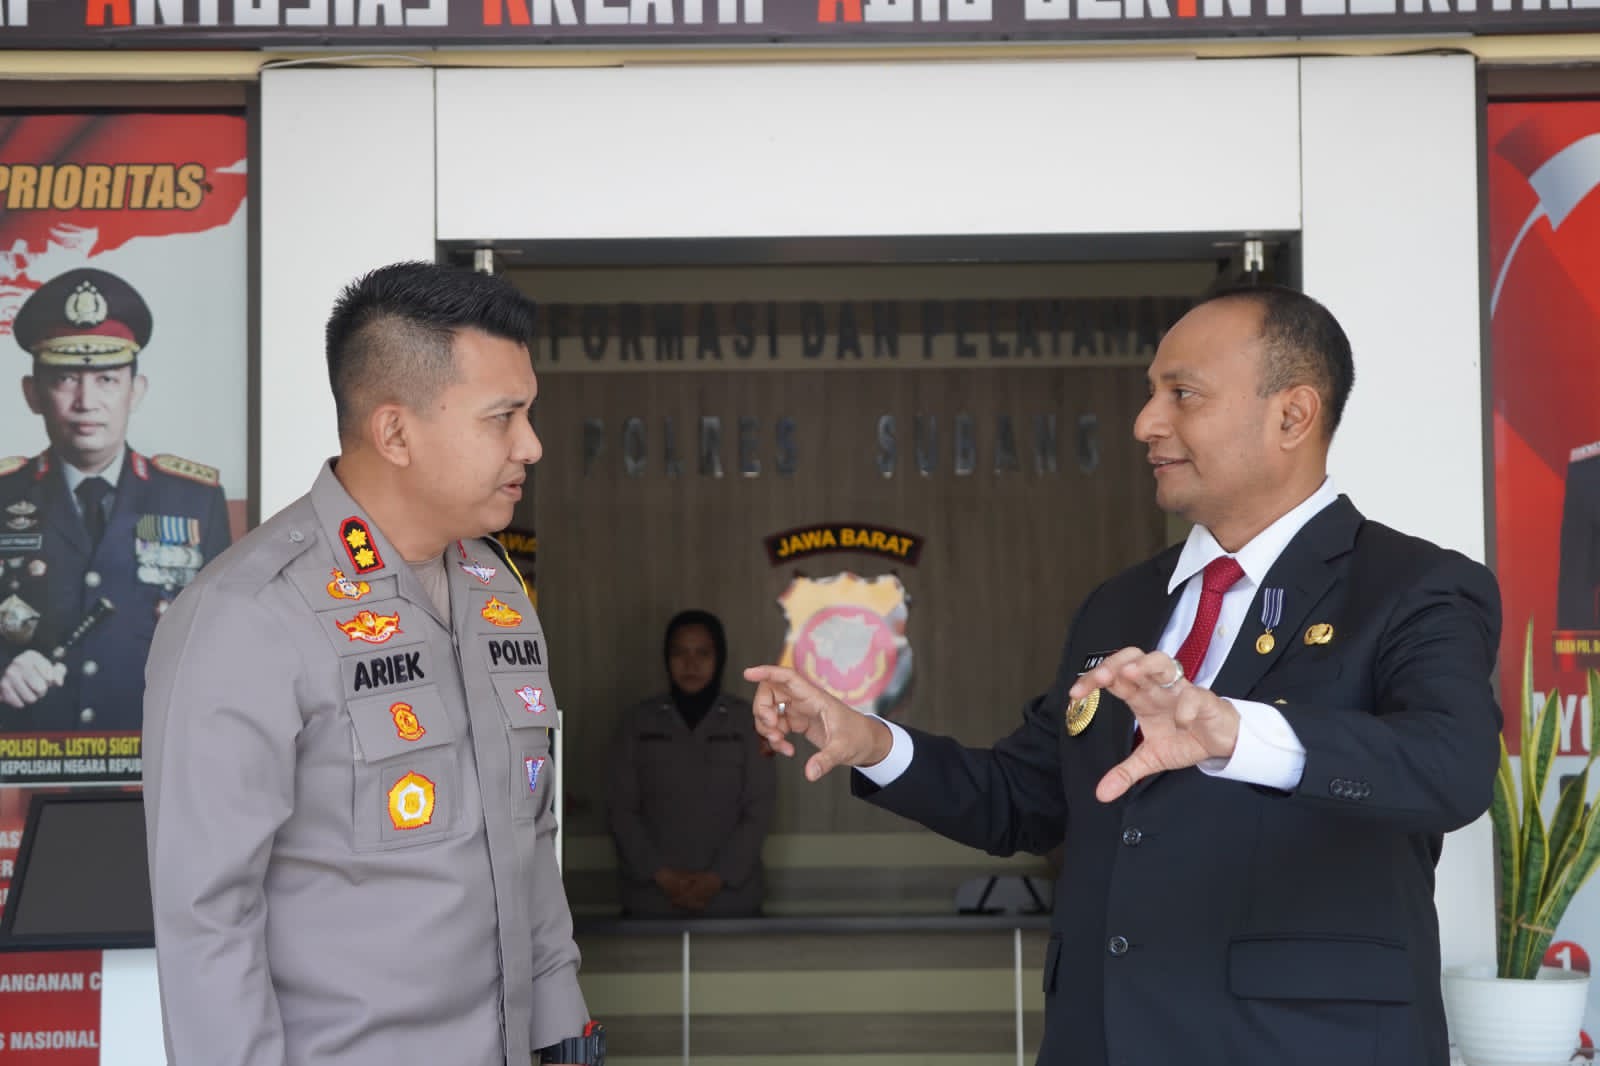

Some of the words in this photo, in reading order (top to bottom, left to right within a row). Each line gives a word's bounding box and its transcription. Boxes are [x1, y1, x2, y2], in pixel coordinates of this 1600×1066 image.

[580, 416, 798, 478] POLRES
[877, 414, 1099, 478] SUBANG
[777, 530, 836, 557] JAWA
[840, 528, 913, 556] BARAT
[488, 640, 542, 666] POLRI
[354, 651, 425, 692] ARIEK
[66, 736, 107, 756] LISTYO
[10, 1030, 99, 1049] NASIONAL
